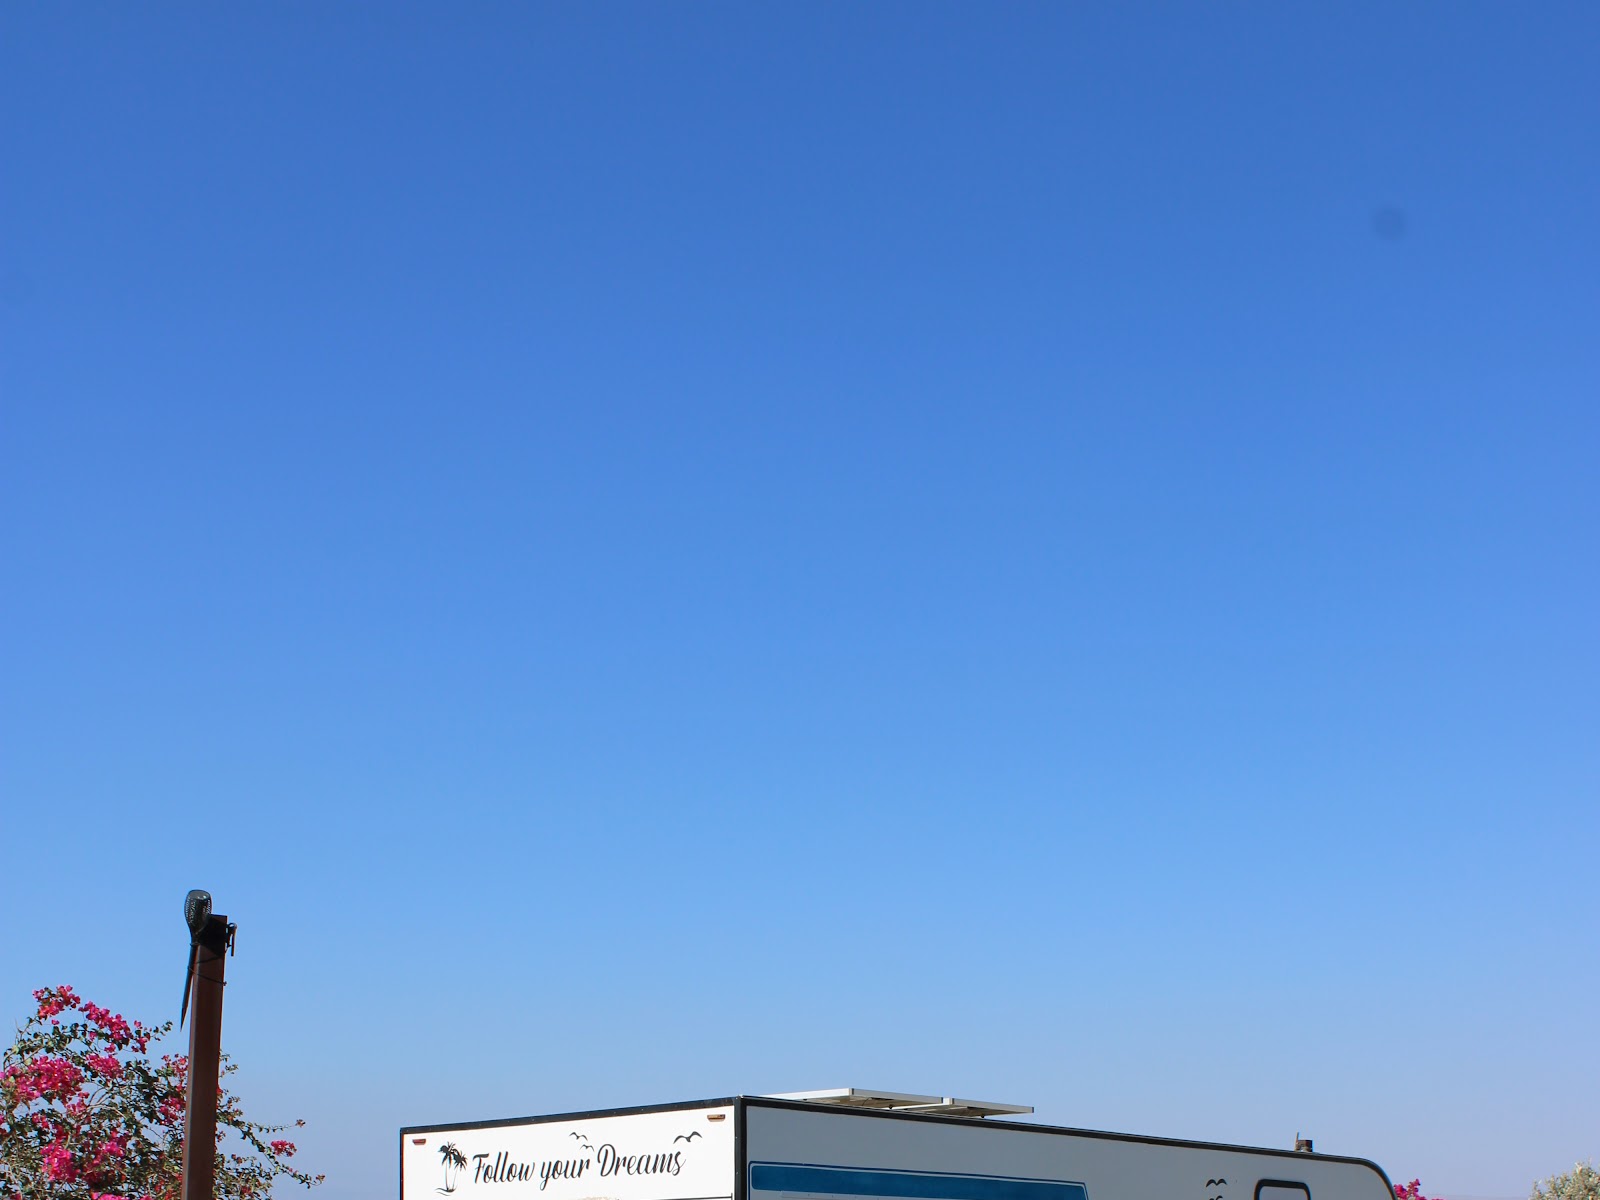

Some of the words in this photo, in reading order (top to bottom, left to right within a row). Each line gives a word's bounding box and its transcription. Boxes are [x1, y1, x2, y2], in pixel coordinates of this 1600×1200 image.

[473, 1151, 536, 1184] Follow
[540, 1157, 591, 1191] your
[597, 1143, 687, 1177] Dreams
